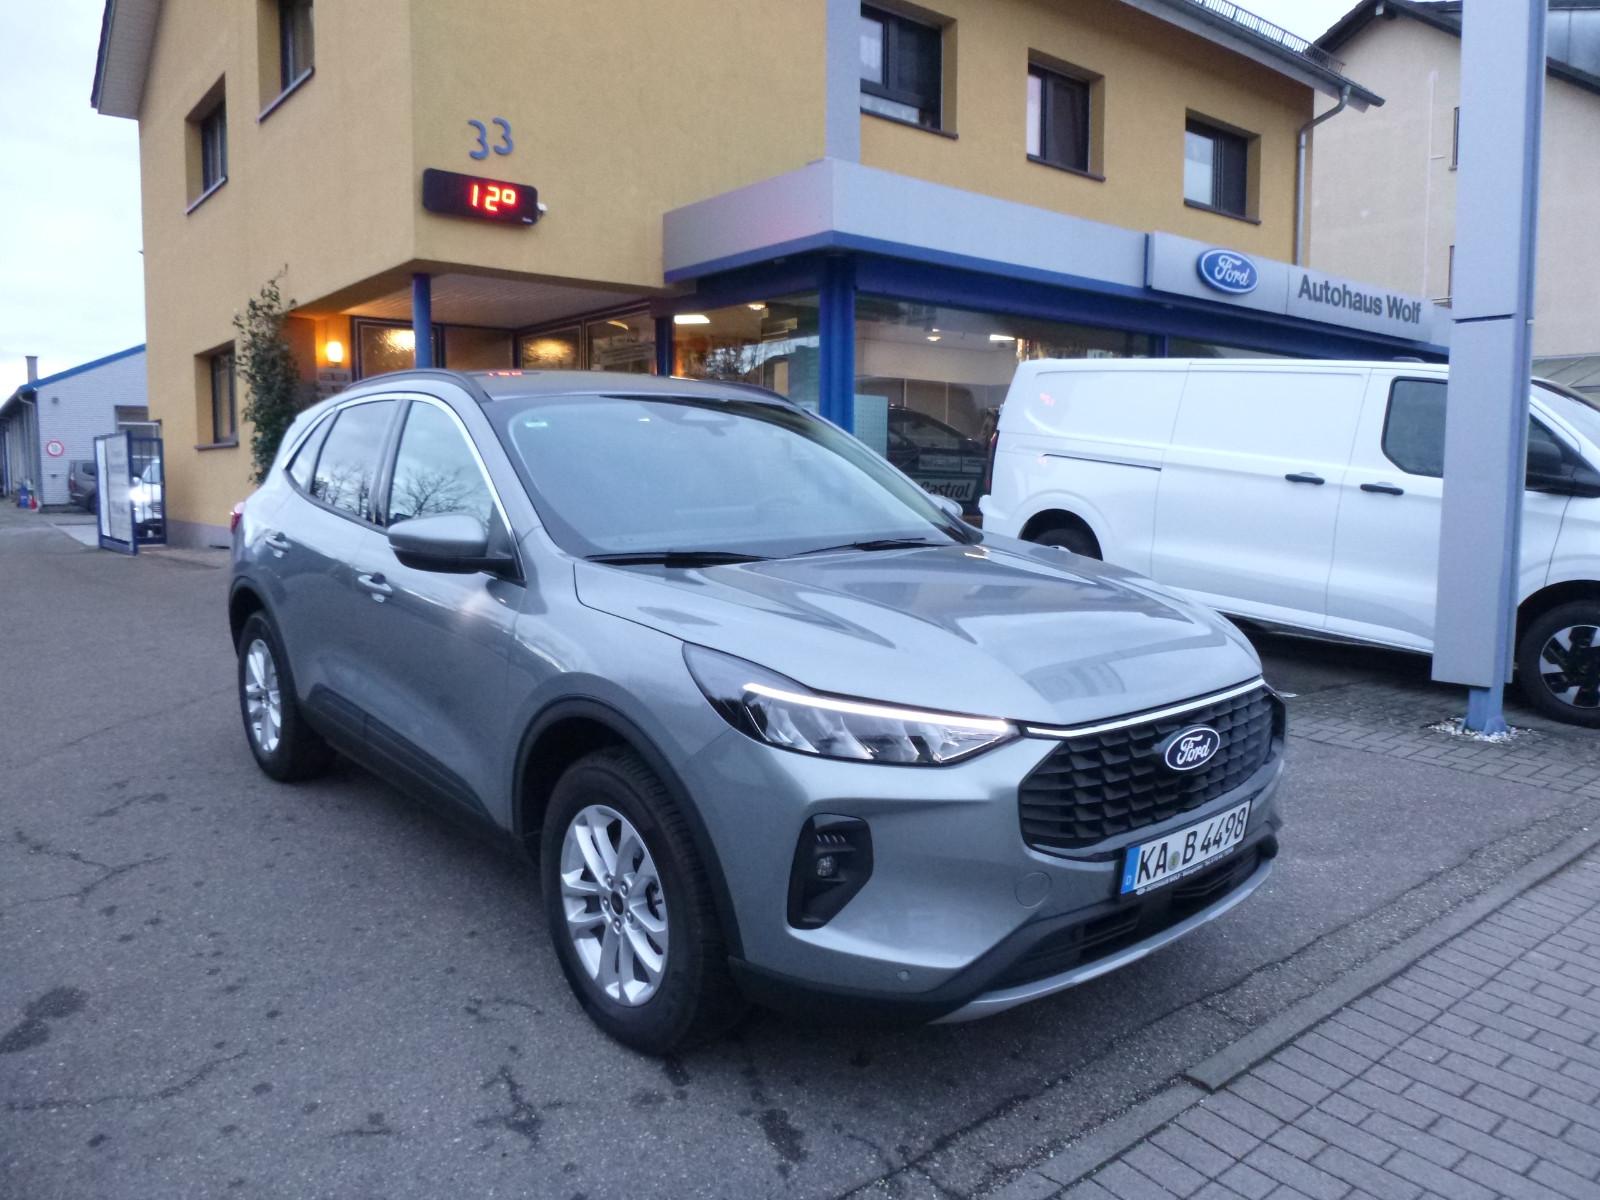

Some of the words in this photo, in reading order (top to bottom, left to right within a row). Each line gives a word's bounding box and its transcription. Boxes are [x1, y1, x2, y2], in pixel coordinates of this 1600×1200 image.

[467, 117, 513, 160] 33
[1214, 255, 1250, 286] Ford
[1298, 274, 1382, 316] Autohaus
[1386, 295, 1421, 324] Wolf
[1176, 734, 1211, 765] Ford
[1137, 842, 1168, 884] KA
[1181, 831, 1198, 865] B
[1200, 807, 1246, 854] 4498
